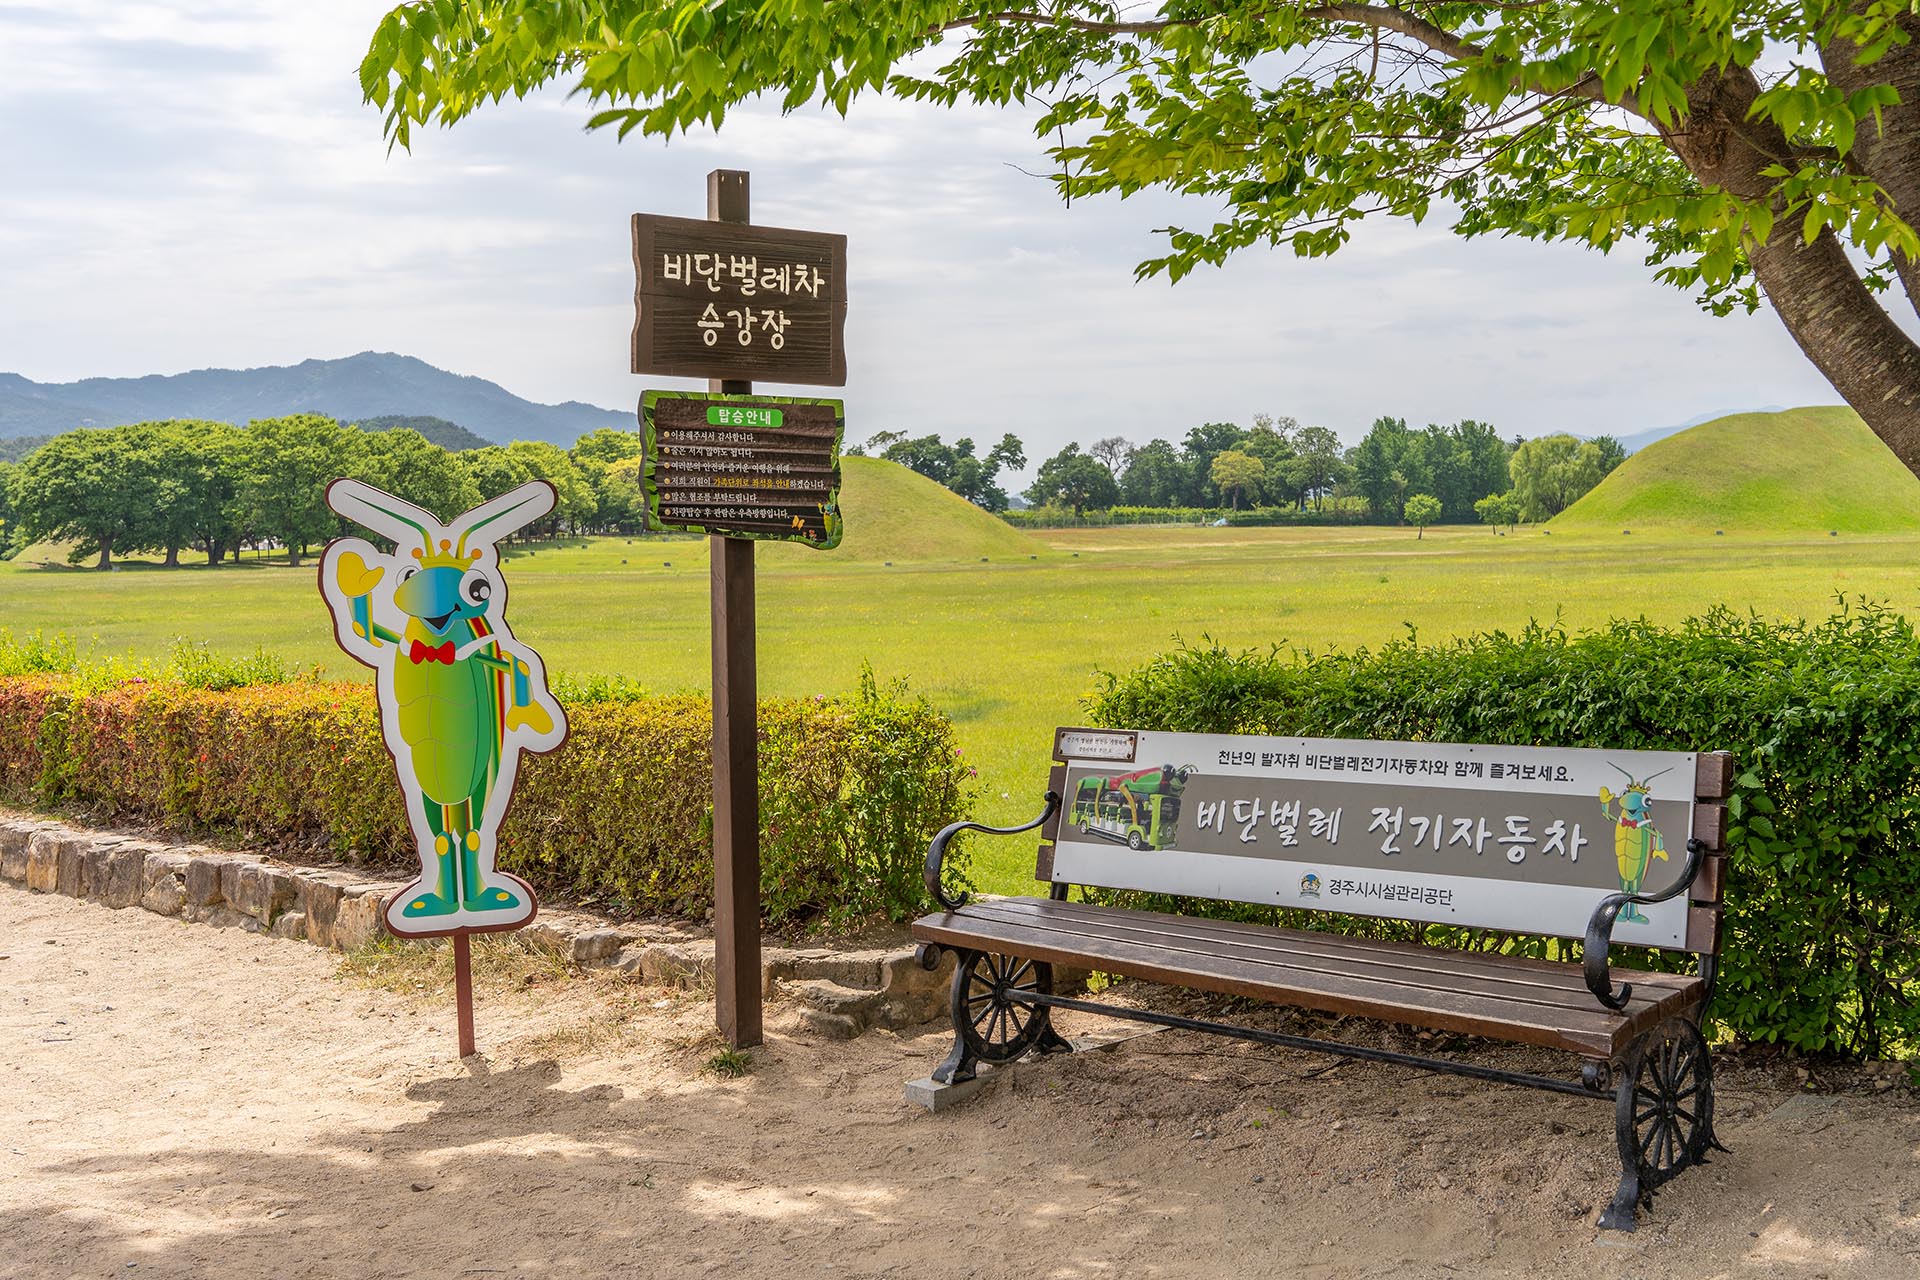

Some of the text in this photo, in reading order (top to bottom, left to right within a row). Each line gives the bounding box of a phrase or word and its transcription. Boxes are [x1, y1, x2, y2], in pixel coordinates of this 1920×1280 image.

[663, 253, 826, 298] 비단벌레차
[697, 302, 791, 350] 승강장
[718, 408, 771, 425] 탑승안내
[671, 431, 756, 443] 이용해주셔서 감사합니다.
[688, 447, 702, 457] 서지
[705, 447, 728, 458] 않아도
[730, 448, 755, 459] 됩니다.
[671, 462, 790, 474] 여러분의 안전과 즐거운 여행을 위해
[671, 477, 685, 486] 저희
[689, 477, 711, 486] 직원이
[713, 477, 749, 488] 가족단위로
[775, 479, 827, 490] 안내하겠습니다.
[671, 492, 759, 503] 많은 협조를 부탁드립니다.
[671, 507, 790, 520] 차량탑승 후 관람은 우측방향입니다.
[1218, 750, 1575, 782] 천년의 발자취 비단벌레전기자동차와 함께 즐겨보세요.
[1196, 797, 1589, 864] 비단벌레 전기자동차
[1329, 879, 1453, 906] 경주시시설관리공단
